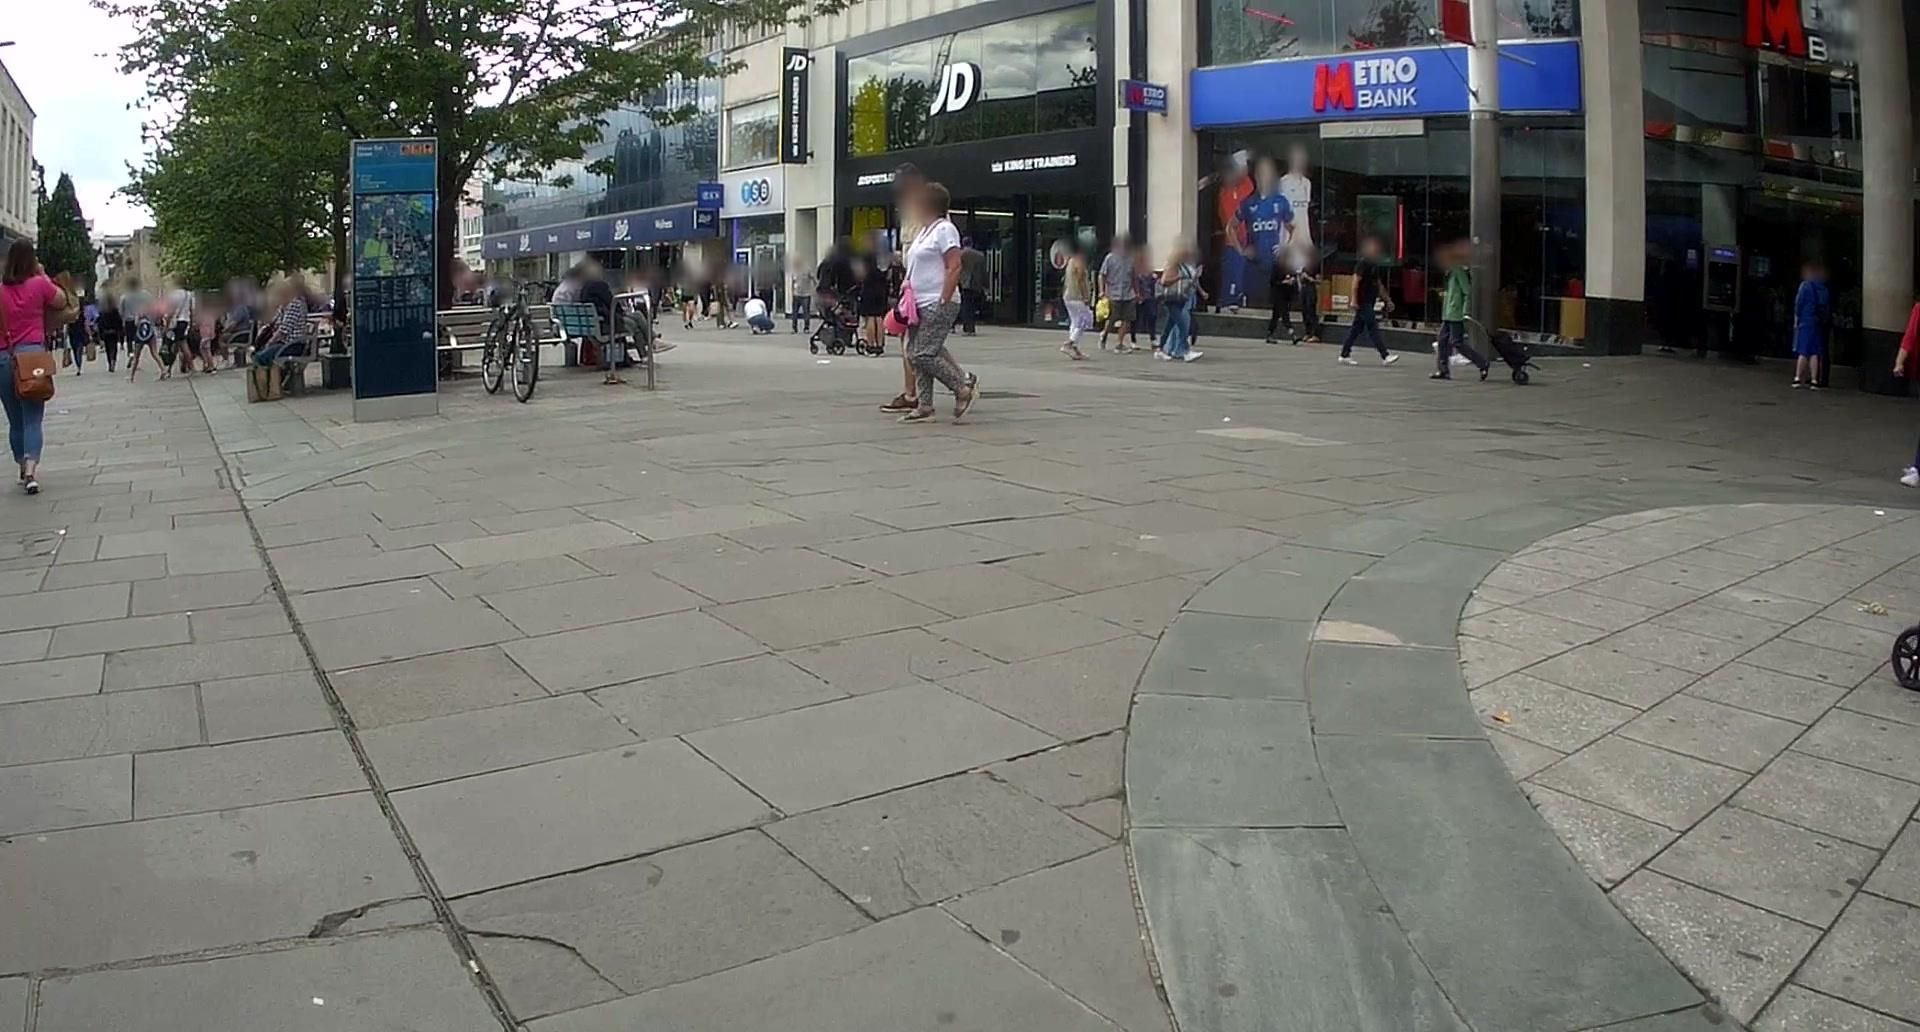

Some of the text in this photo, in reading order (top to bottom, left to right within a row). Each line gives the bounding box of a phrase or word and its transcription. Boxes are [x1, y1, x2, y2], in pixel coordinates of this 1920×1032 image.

[786, 54, 807, 71] JD
[930, 62, 974, 117] JD
[1314, 56, 1417, 112] METRO
[1358, 87, 1417, 109] BANK
[1004, 159, 1024, 171] KING
[1034, 155, 1077, 169] TRAINERS
[742, 179, 769, 203] TSB
